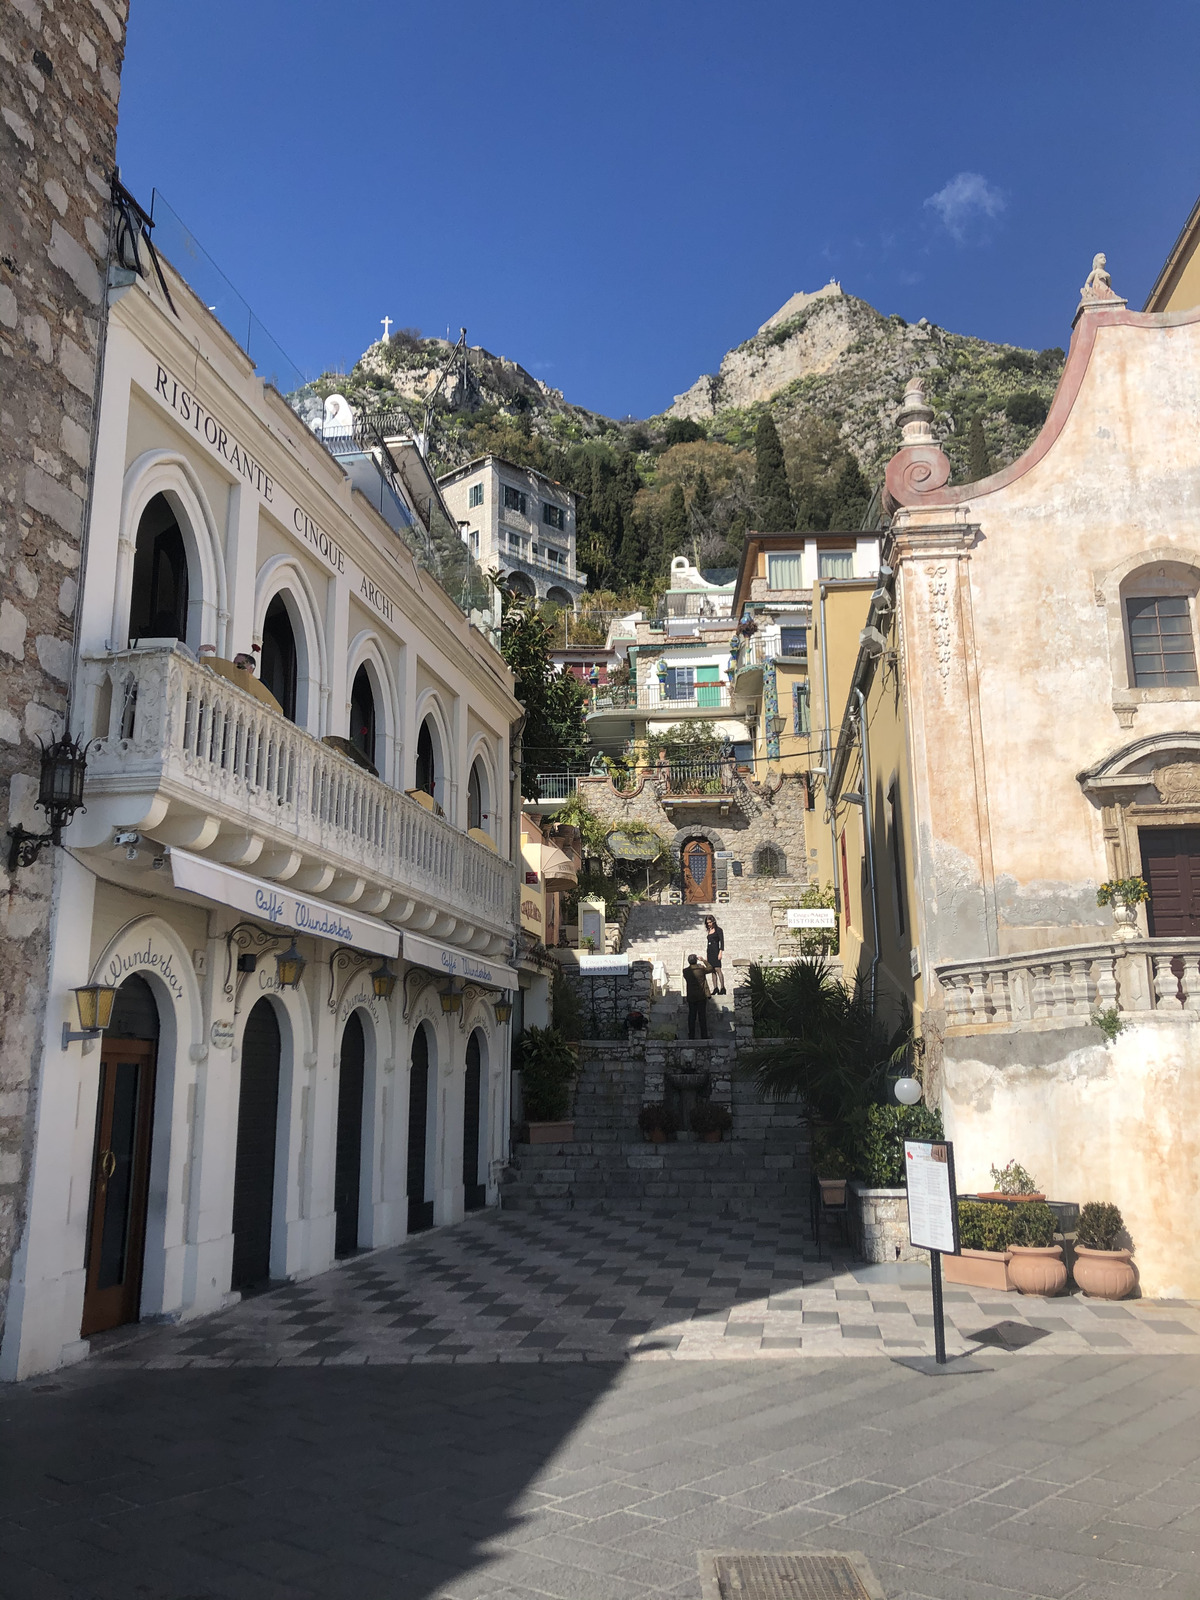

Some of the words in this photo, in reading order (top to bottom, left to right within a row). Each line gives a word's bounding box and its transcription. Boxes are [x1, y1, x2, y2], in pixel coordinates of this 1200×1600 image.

[156, 363, 274, 504] RISTORANTE
[293, 507, 345, 575] CINQUE
[359, 575, 394, 623] ARCHI
[255, 889, 284, 922] Caffé
[295, 901, 354, 942] Wunderbar
[104, 938, 184, 1000] Wunderbar
